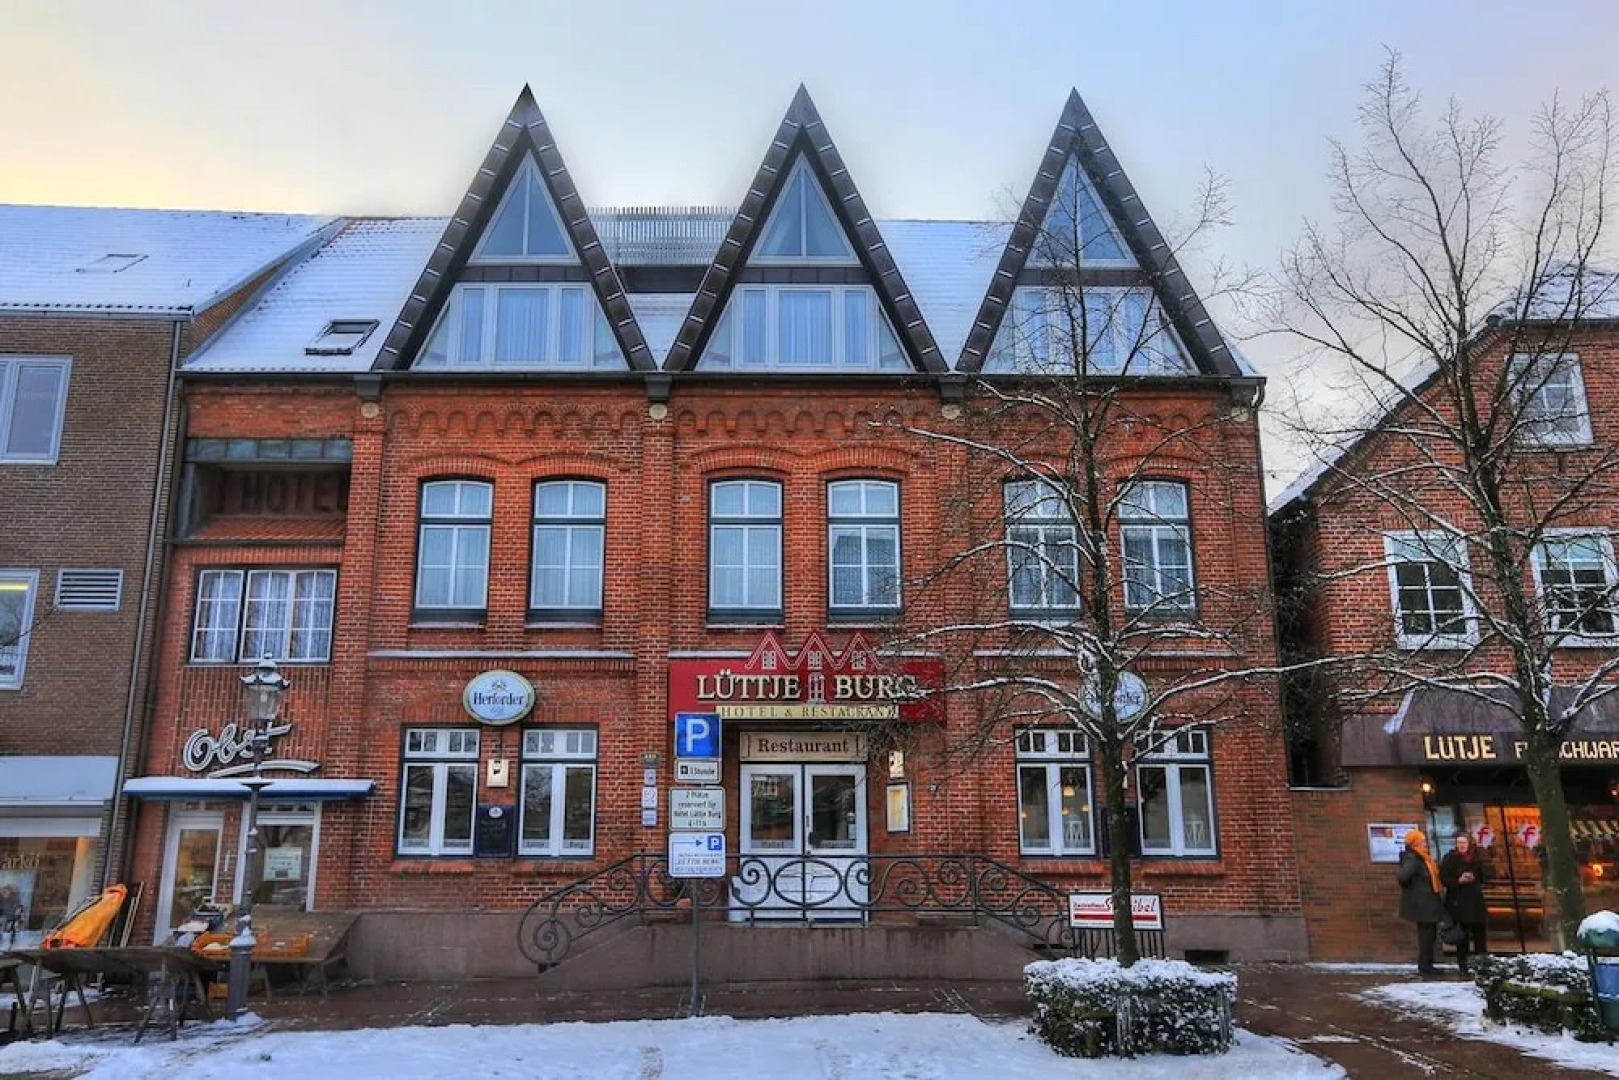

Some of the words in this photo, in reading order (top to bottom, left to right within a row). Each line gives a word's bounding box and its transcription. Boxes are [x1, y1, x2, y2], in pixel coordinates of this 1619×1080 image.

[697, 668, 801, 699] LÜTTJE
[833, 674, 918, 699] BURG
[473, 692, 525, 706] Herforder
[721, 706, 777, 718] HOTEL
[685, 718, 710, 752] P
[757, 738, 849, 753] Restaurant
[1424, 736, 1497, 760] LUTJE
[711, 837, 720, 850] P
